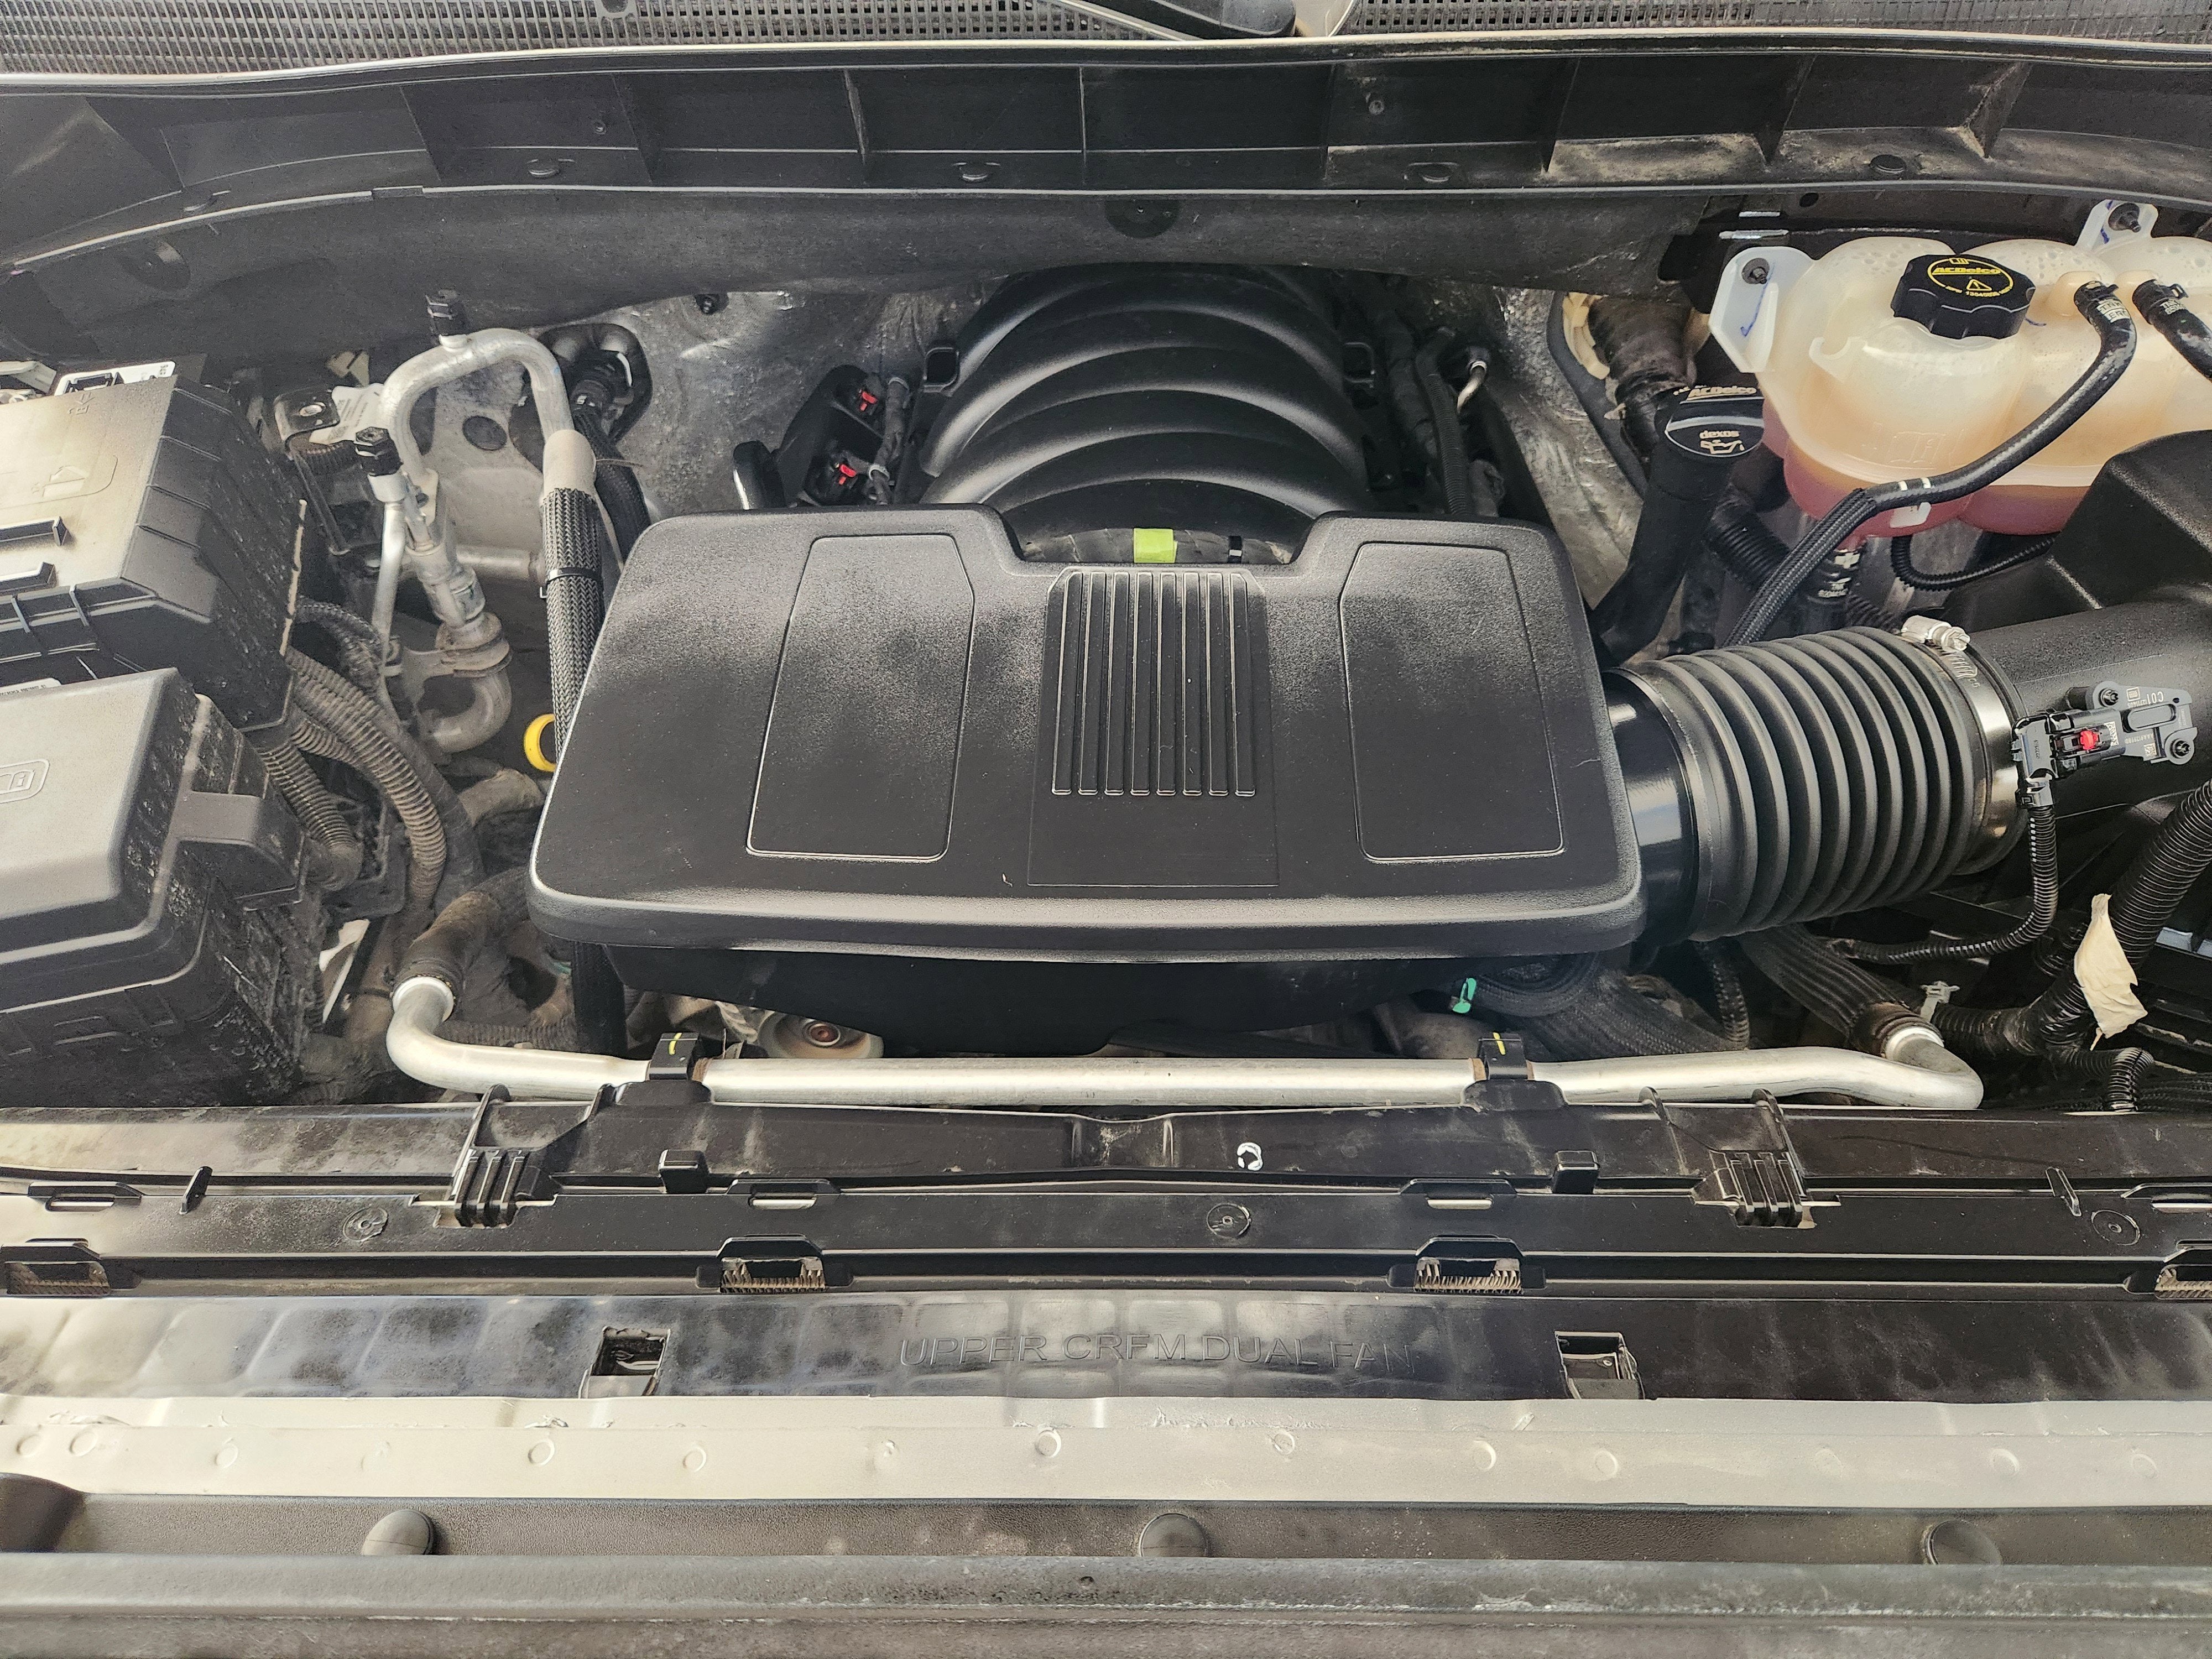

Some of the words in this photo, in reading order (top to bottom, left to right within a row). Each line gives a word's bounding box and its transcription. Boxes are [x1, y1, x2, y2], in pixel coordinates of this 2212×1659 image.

[1687, 386, 1757, 400] ACDelco
[1699, 430, 1740, 439] dexos
[900, 1333, 1047, 1366] UPPER
[1063, 1332, 1187, 1361] CRFM
[1202, 1334, 1318, 1367] DUAL
[1329, 1340, 1416, 1374] FAN
